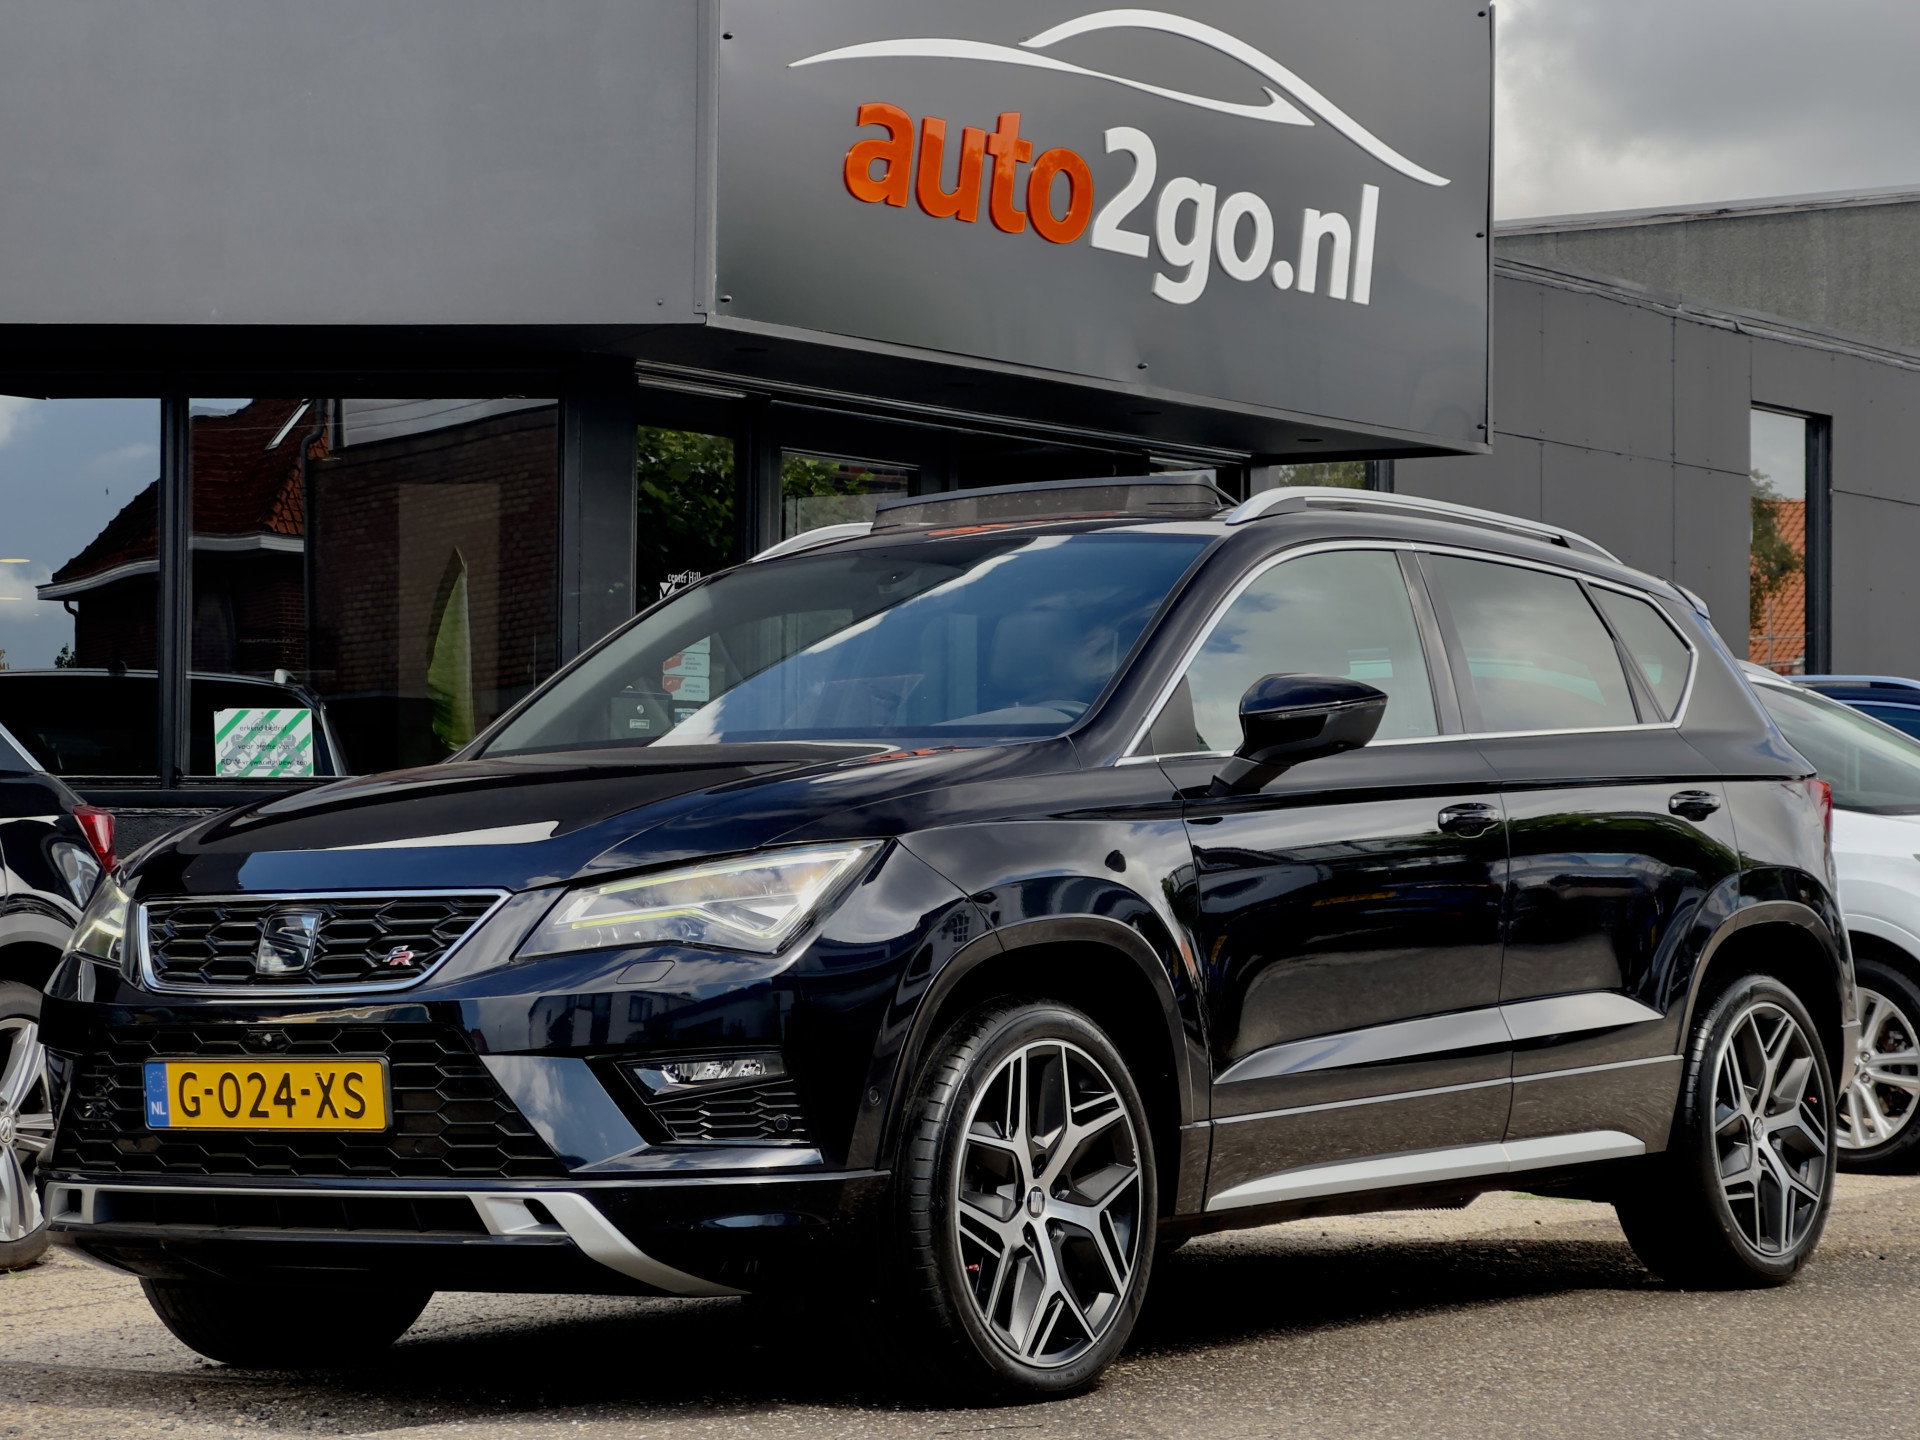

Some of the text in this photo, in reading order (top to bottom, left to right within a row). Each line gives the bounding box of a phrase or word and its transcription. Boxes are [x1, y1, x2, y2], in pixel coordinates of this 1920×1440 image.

[843, 102, 1379, 305] auto2go.nl
[151, 1101, 167, 1116] NL
[178, 1071, 366, 1119] G-024-XS
